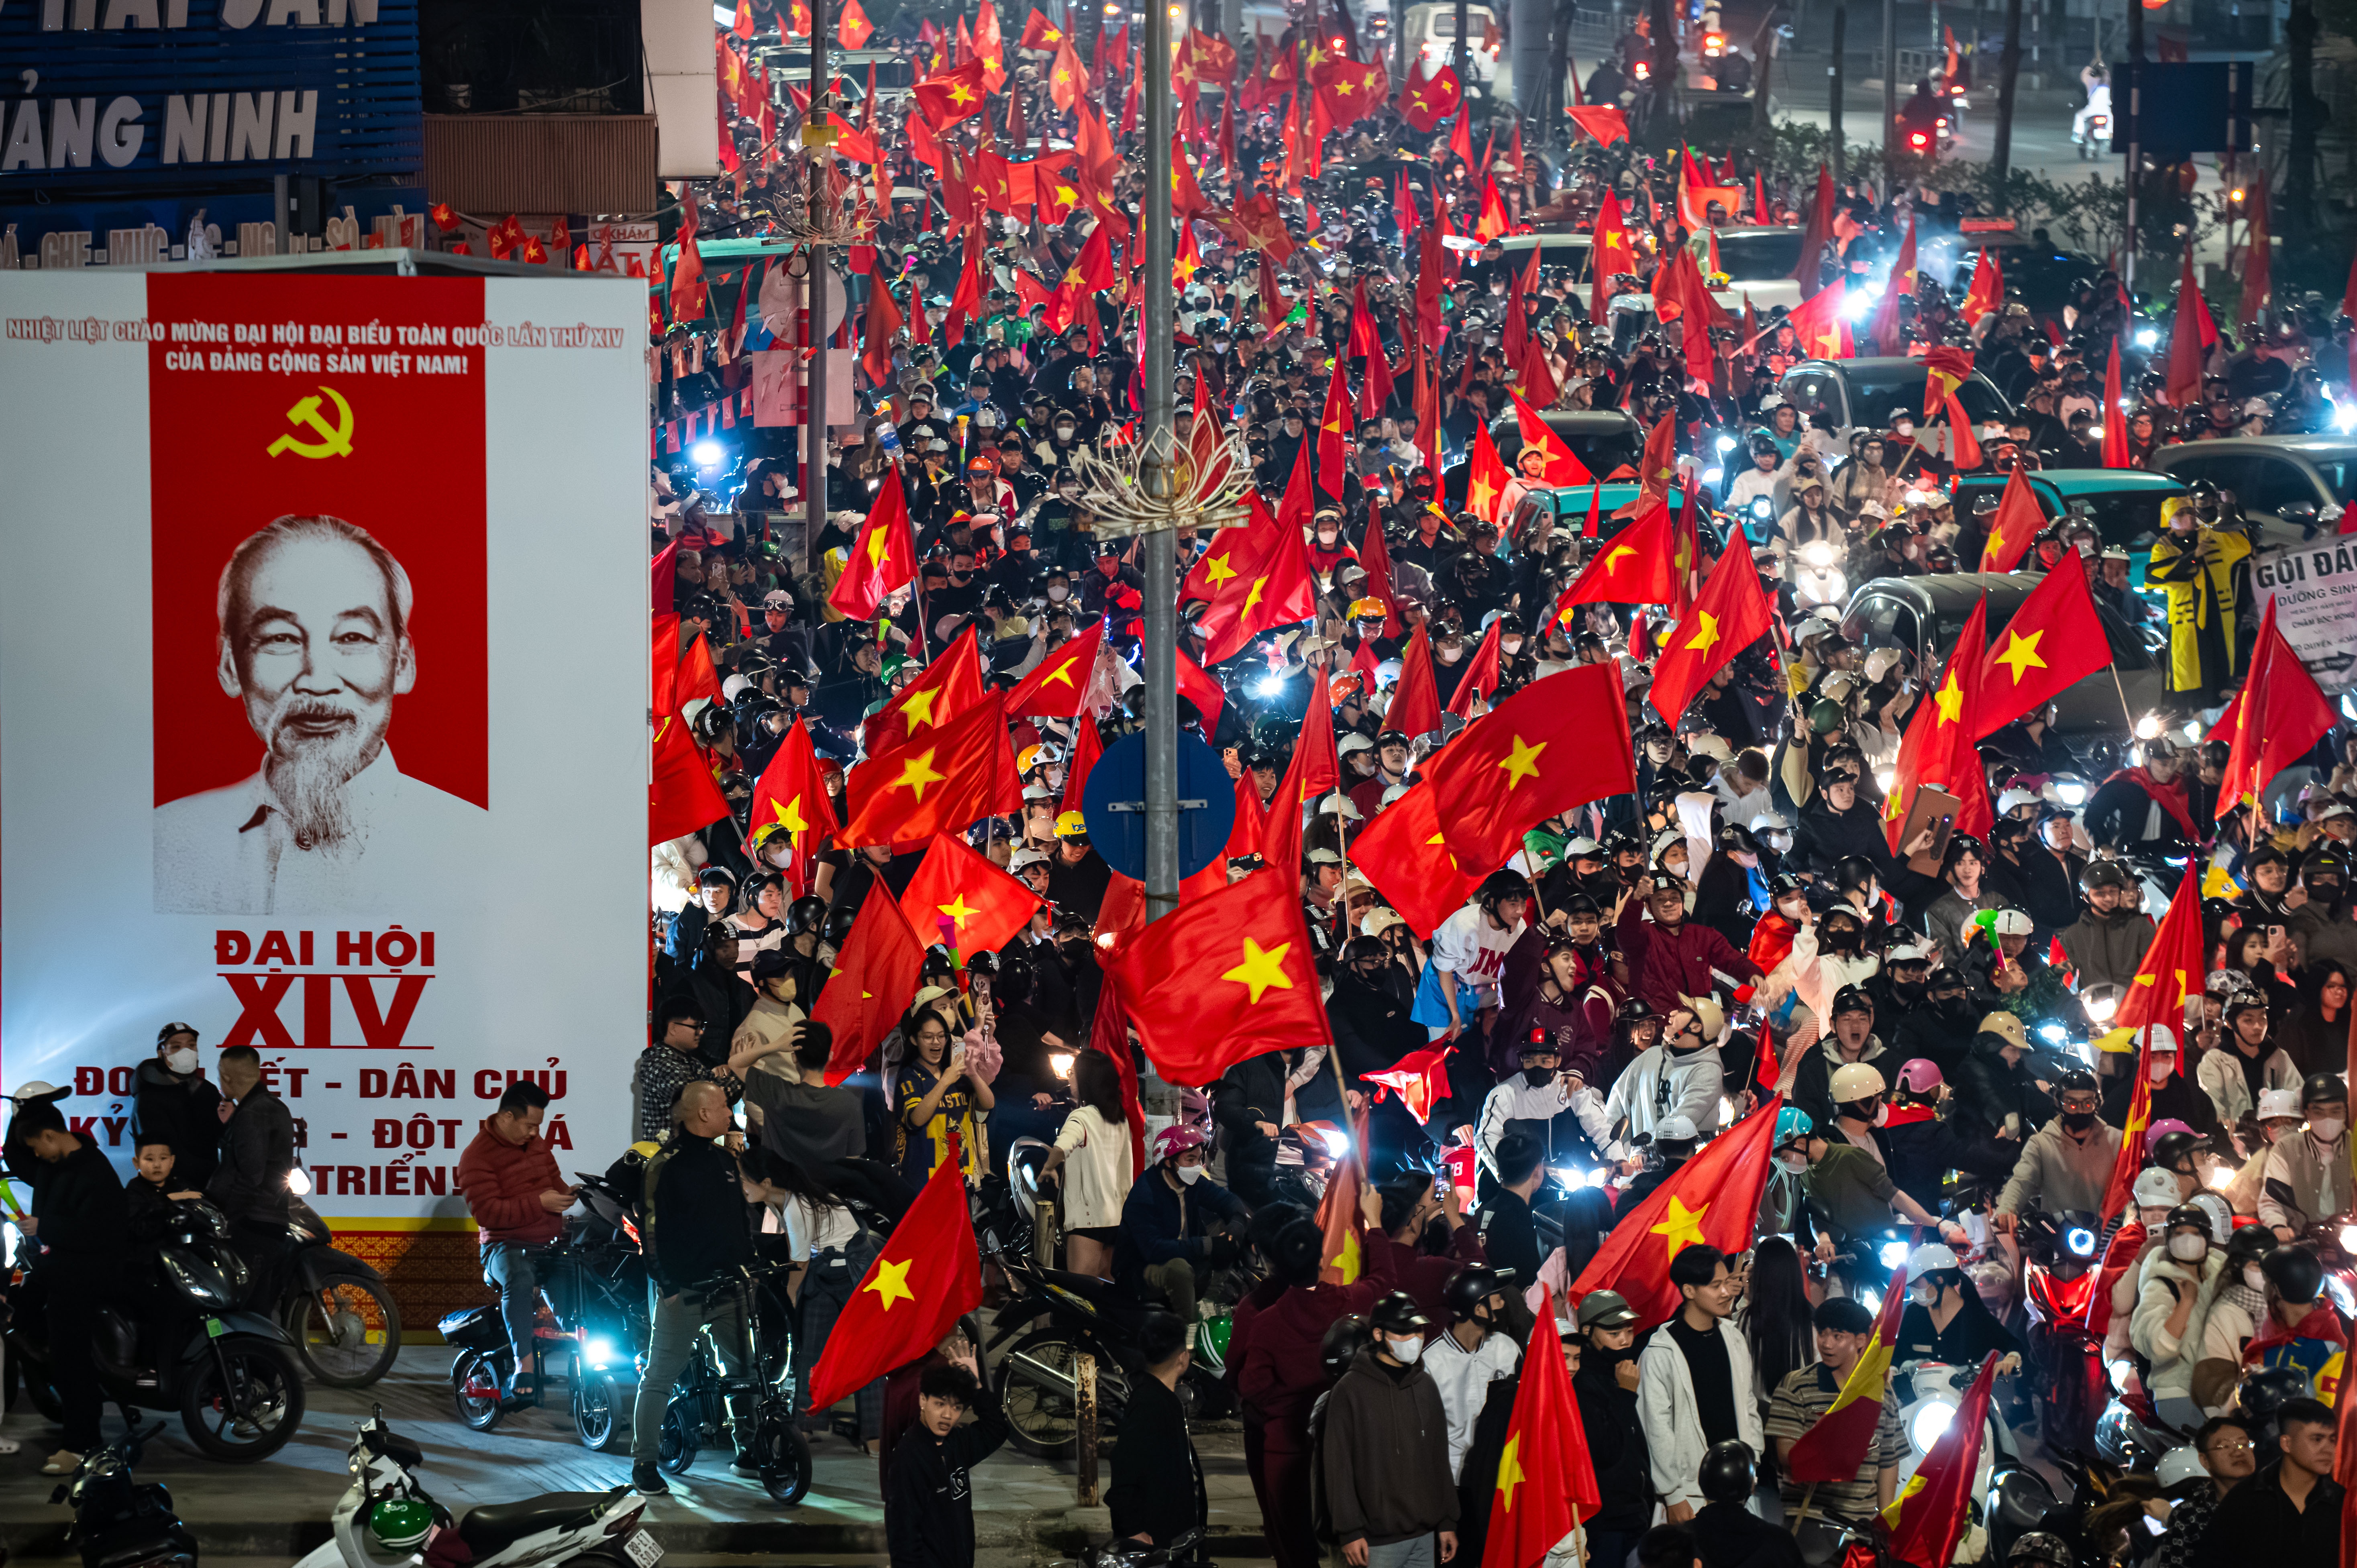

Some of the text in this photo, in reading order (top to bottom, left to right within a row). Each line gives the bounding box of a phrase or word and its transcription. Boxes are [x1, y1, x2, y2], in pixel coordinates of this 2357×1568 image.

[0, 69, 318, 170] ẢNG NINH
[6, 316, 624, 348] NHIỆT LIỆT CHÀO MỪNG ĐẠI HỘI ĐẠI BIỂU TOÀN QUỐC LẦN THỨ XIV
[165, 343, 468, 377] CỦA ĐẢNG CỘNG SẢN VIỆT NAM!
[2313, 540, 2357, 576] ĐẦ
[214, 925, 435, 973] ĐẠI HỘI
[217, 973, 435, 1049] XIV
[260, 1057, 309, 1098] ẾT
[359, 1062, 456, 1099] DÂN
[372, 1113, 463, 1156] ĐỘT
[1451, 1161, 1463, 1177] 8
